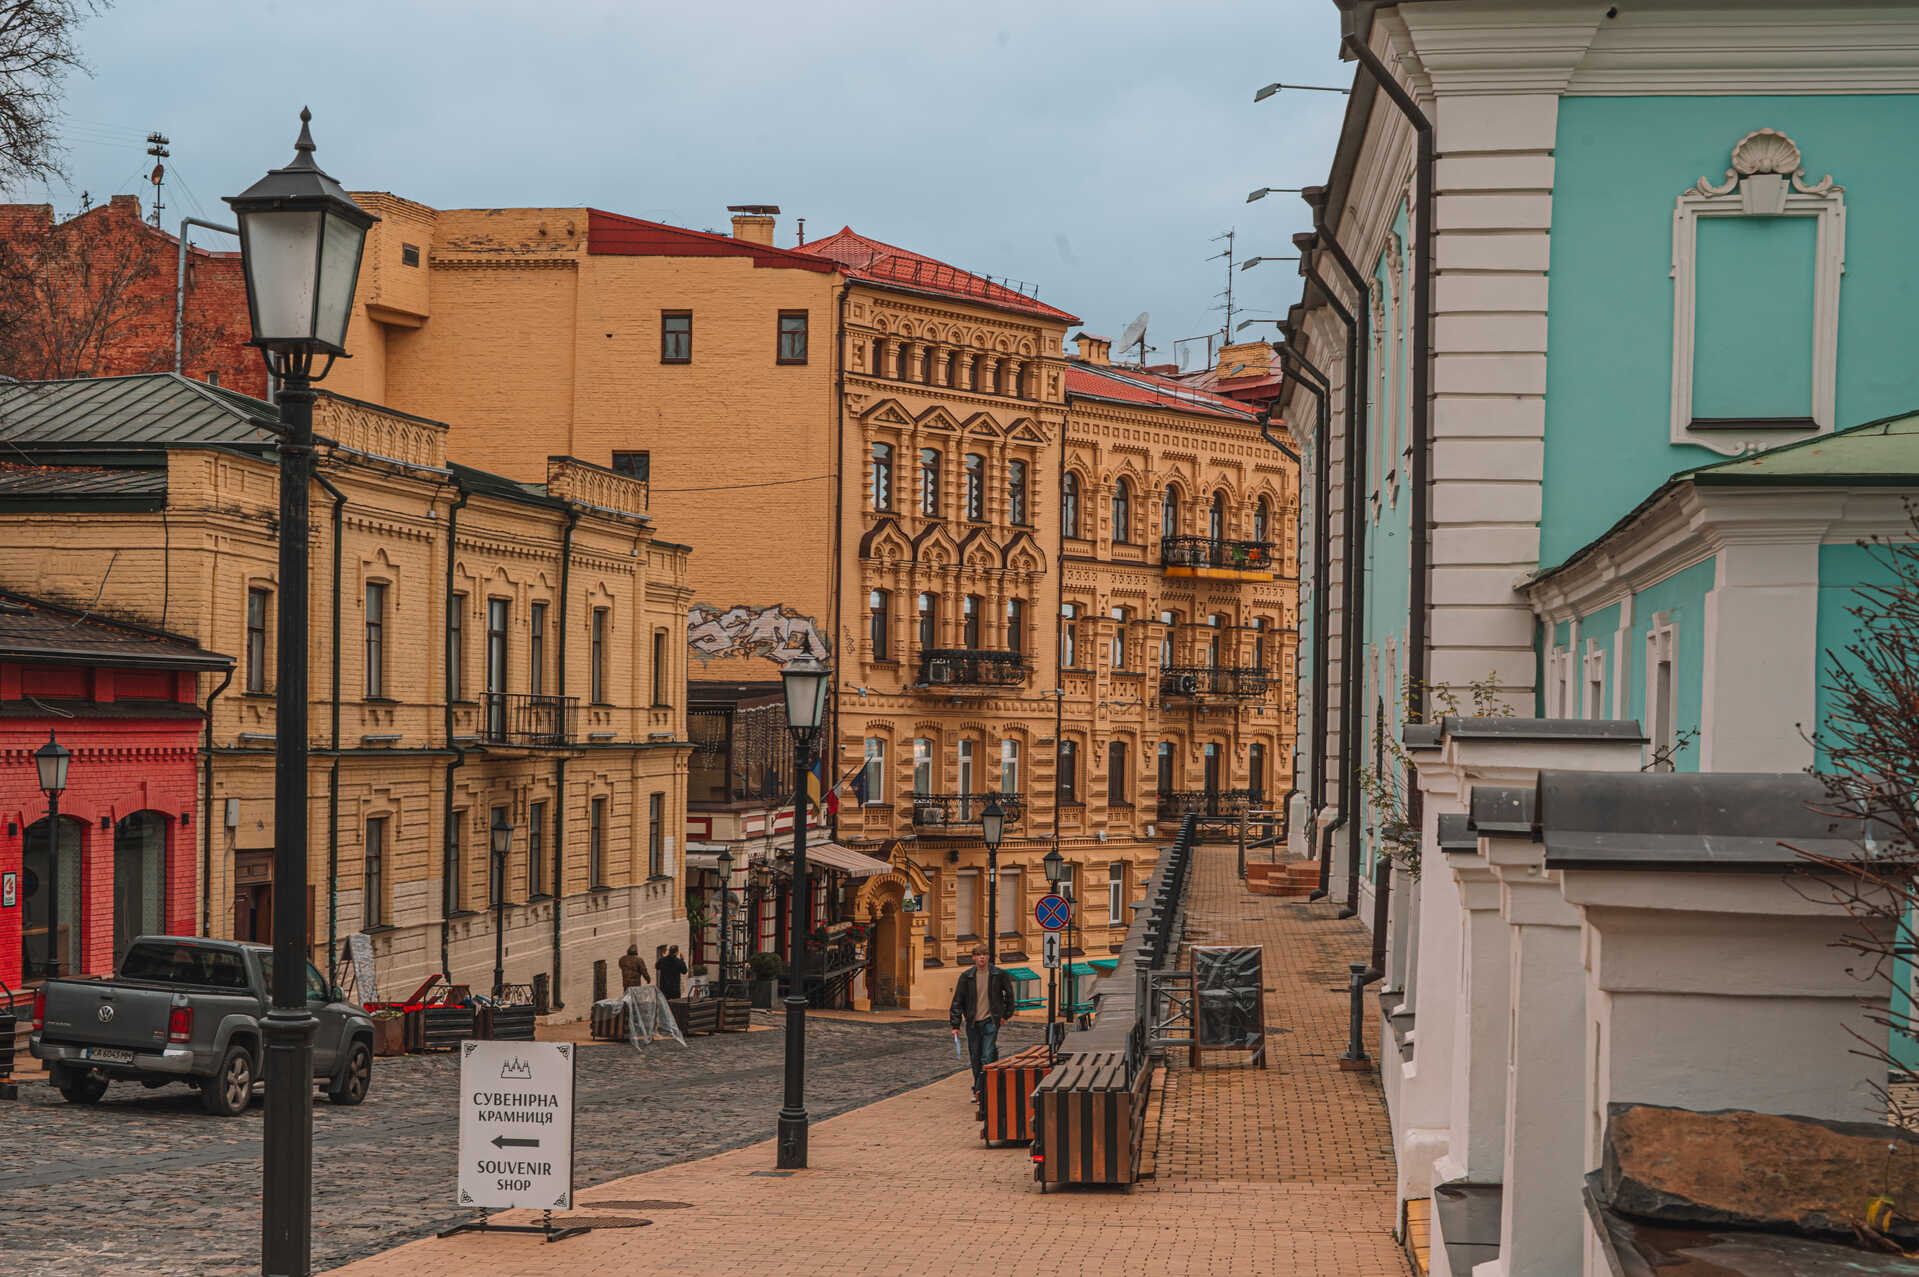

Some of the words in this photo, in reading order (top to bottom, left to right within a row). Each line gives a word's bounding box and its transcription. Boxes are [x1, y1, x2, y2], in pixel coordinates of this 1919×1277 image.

[473, 1092, 559, 1108] СУВЕНІРНА
[478, 1110, 553, 1125] КРАМНИЦЯ
[477, 1160, 552, 1176] SOUVENIR
[497, 1178, 532, 1191] SHOP
